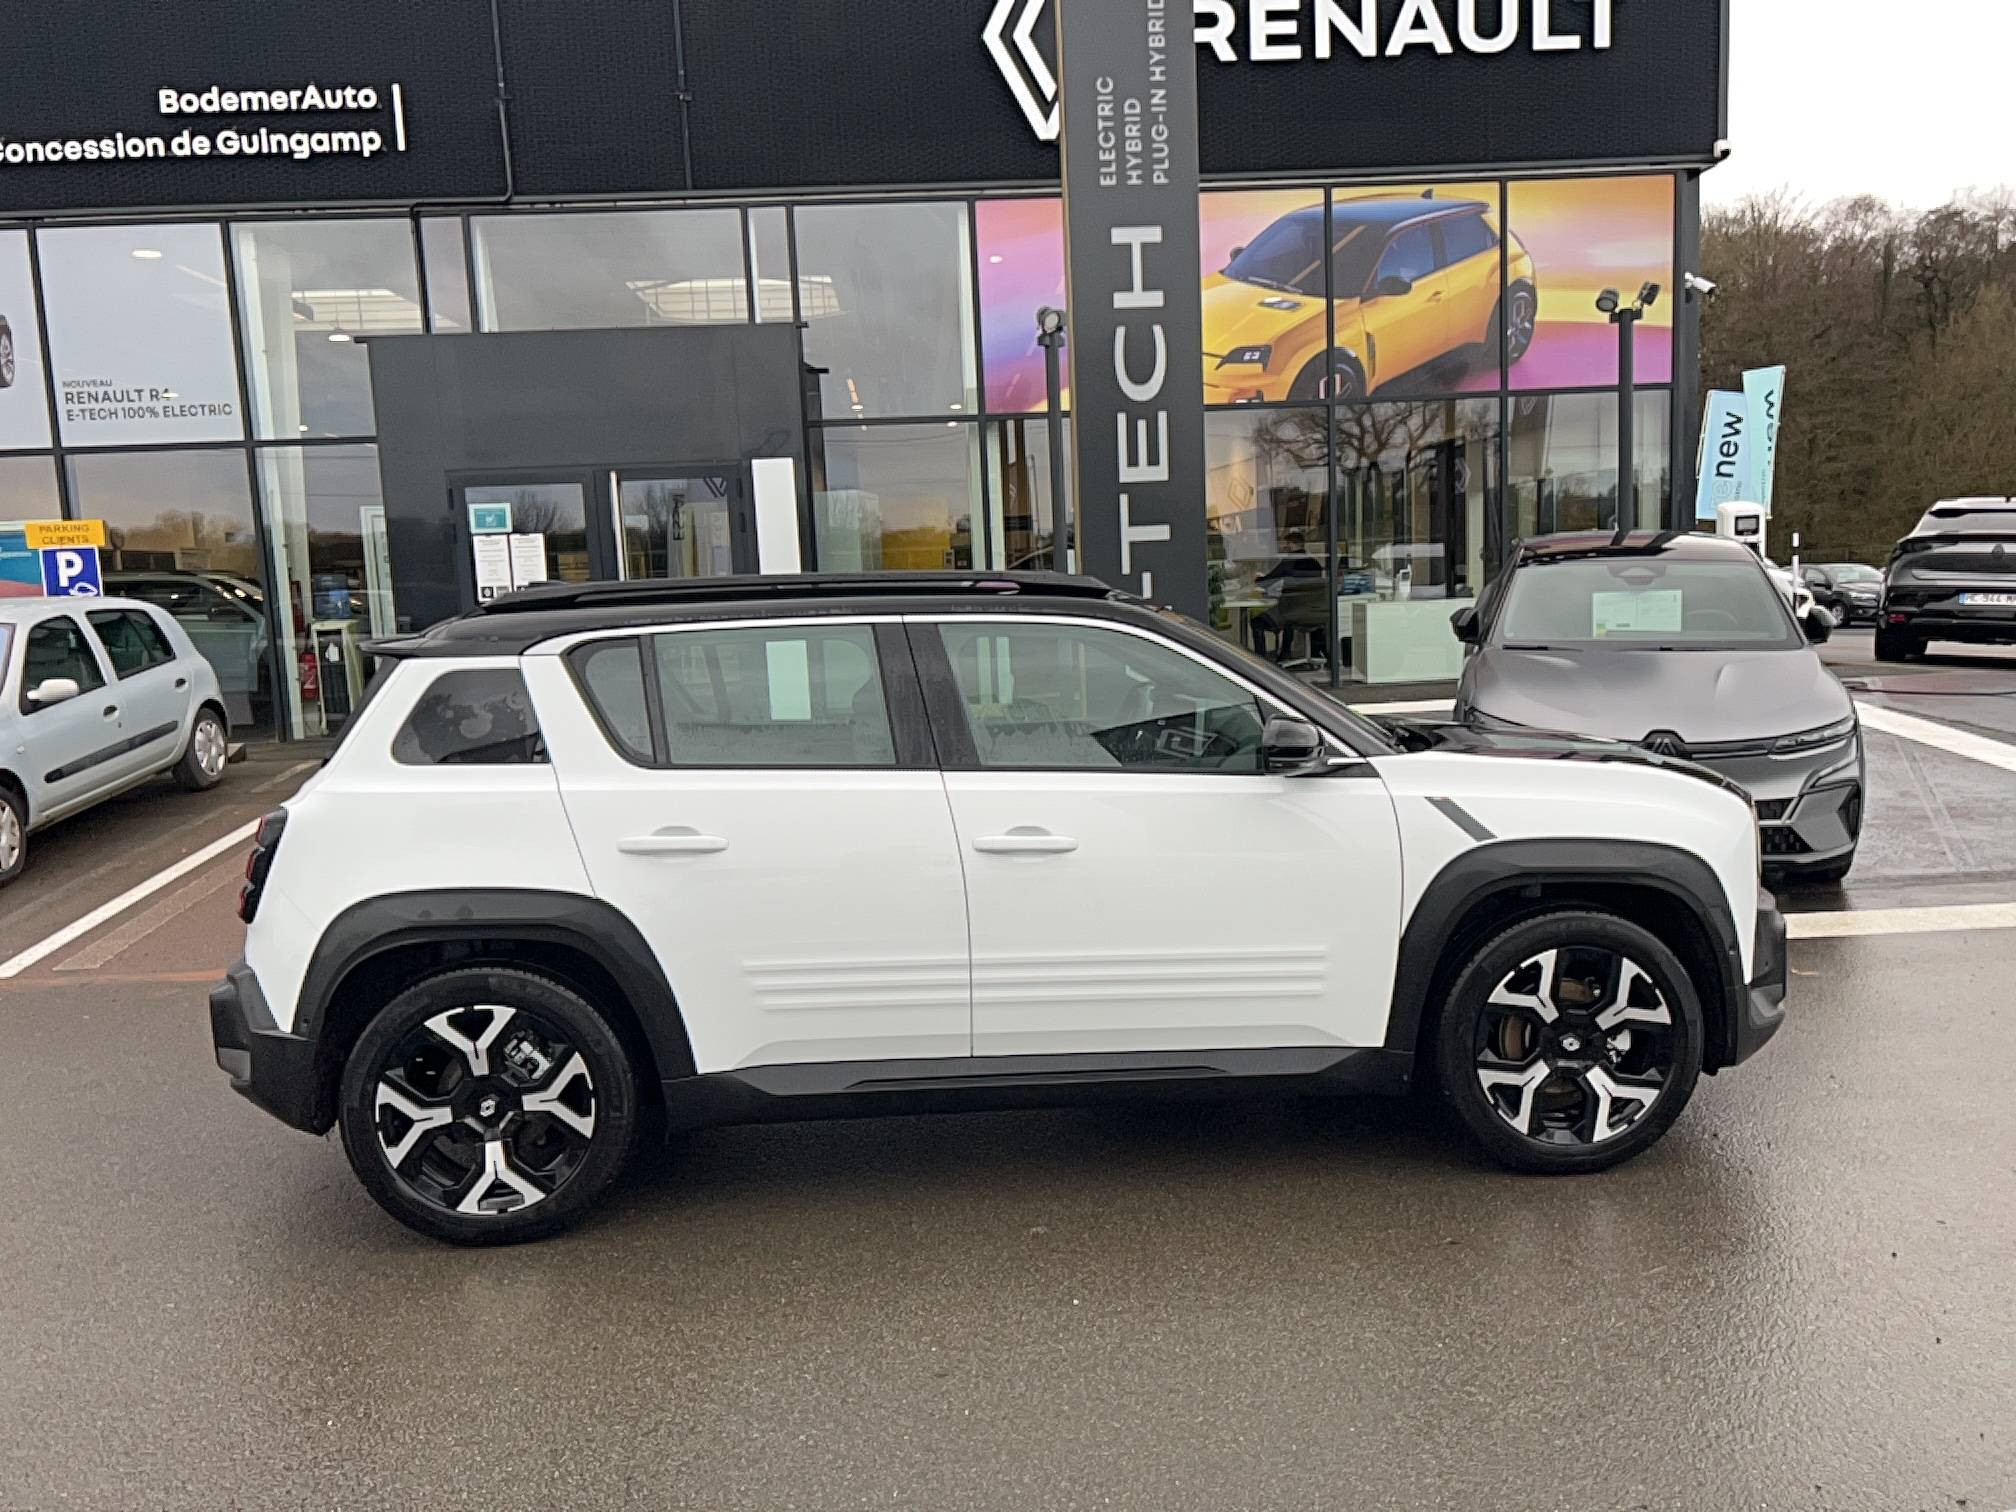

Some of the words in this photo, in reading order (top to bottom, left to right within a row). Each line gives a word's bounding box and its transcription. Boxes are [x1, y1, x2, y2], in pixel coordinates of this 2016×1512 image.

[158, 84, 378, 114] BodemerAuto
[0, 132, 166, 163] oncession
[171, 129, 211, 156] de
[216, 127, 382, 160] Guingamp
[1096, 76, 1117, 186] ELECTRIC
[1124, 97, 1144, 186] HYBRID
[1150, 88, 1170, 185] PLUG-IN
[62, 379, 113, 388] NOUVEAU
[65, 388, 144, 405] RENAULT
[66, 407, 119, 422] E-TECH
[121, 406, 160, 419] 100%
[163, 403, 233, 418] ELECTRIC
[1110, 225, 1171, 608] -TECH
[39, 524, 90, 533] PARKING
[42, 534, 89, 545] CLIENTS
[56, 551, 84, 588] P
